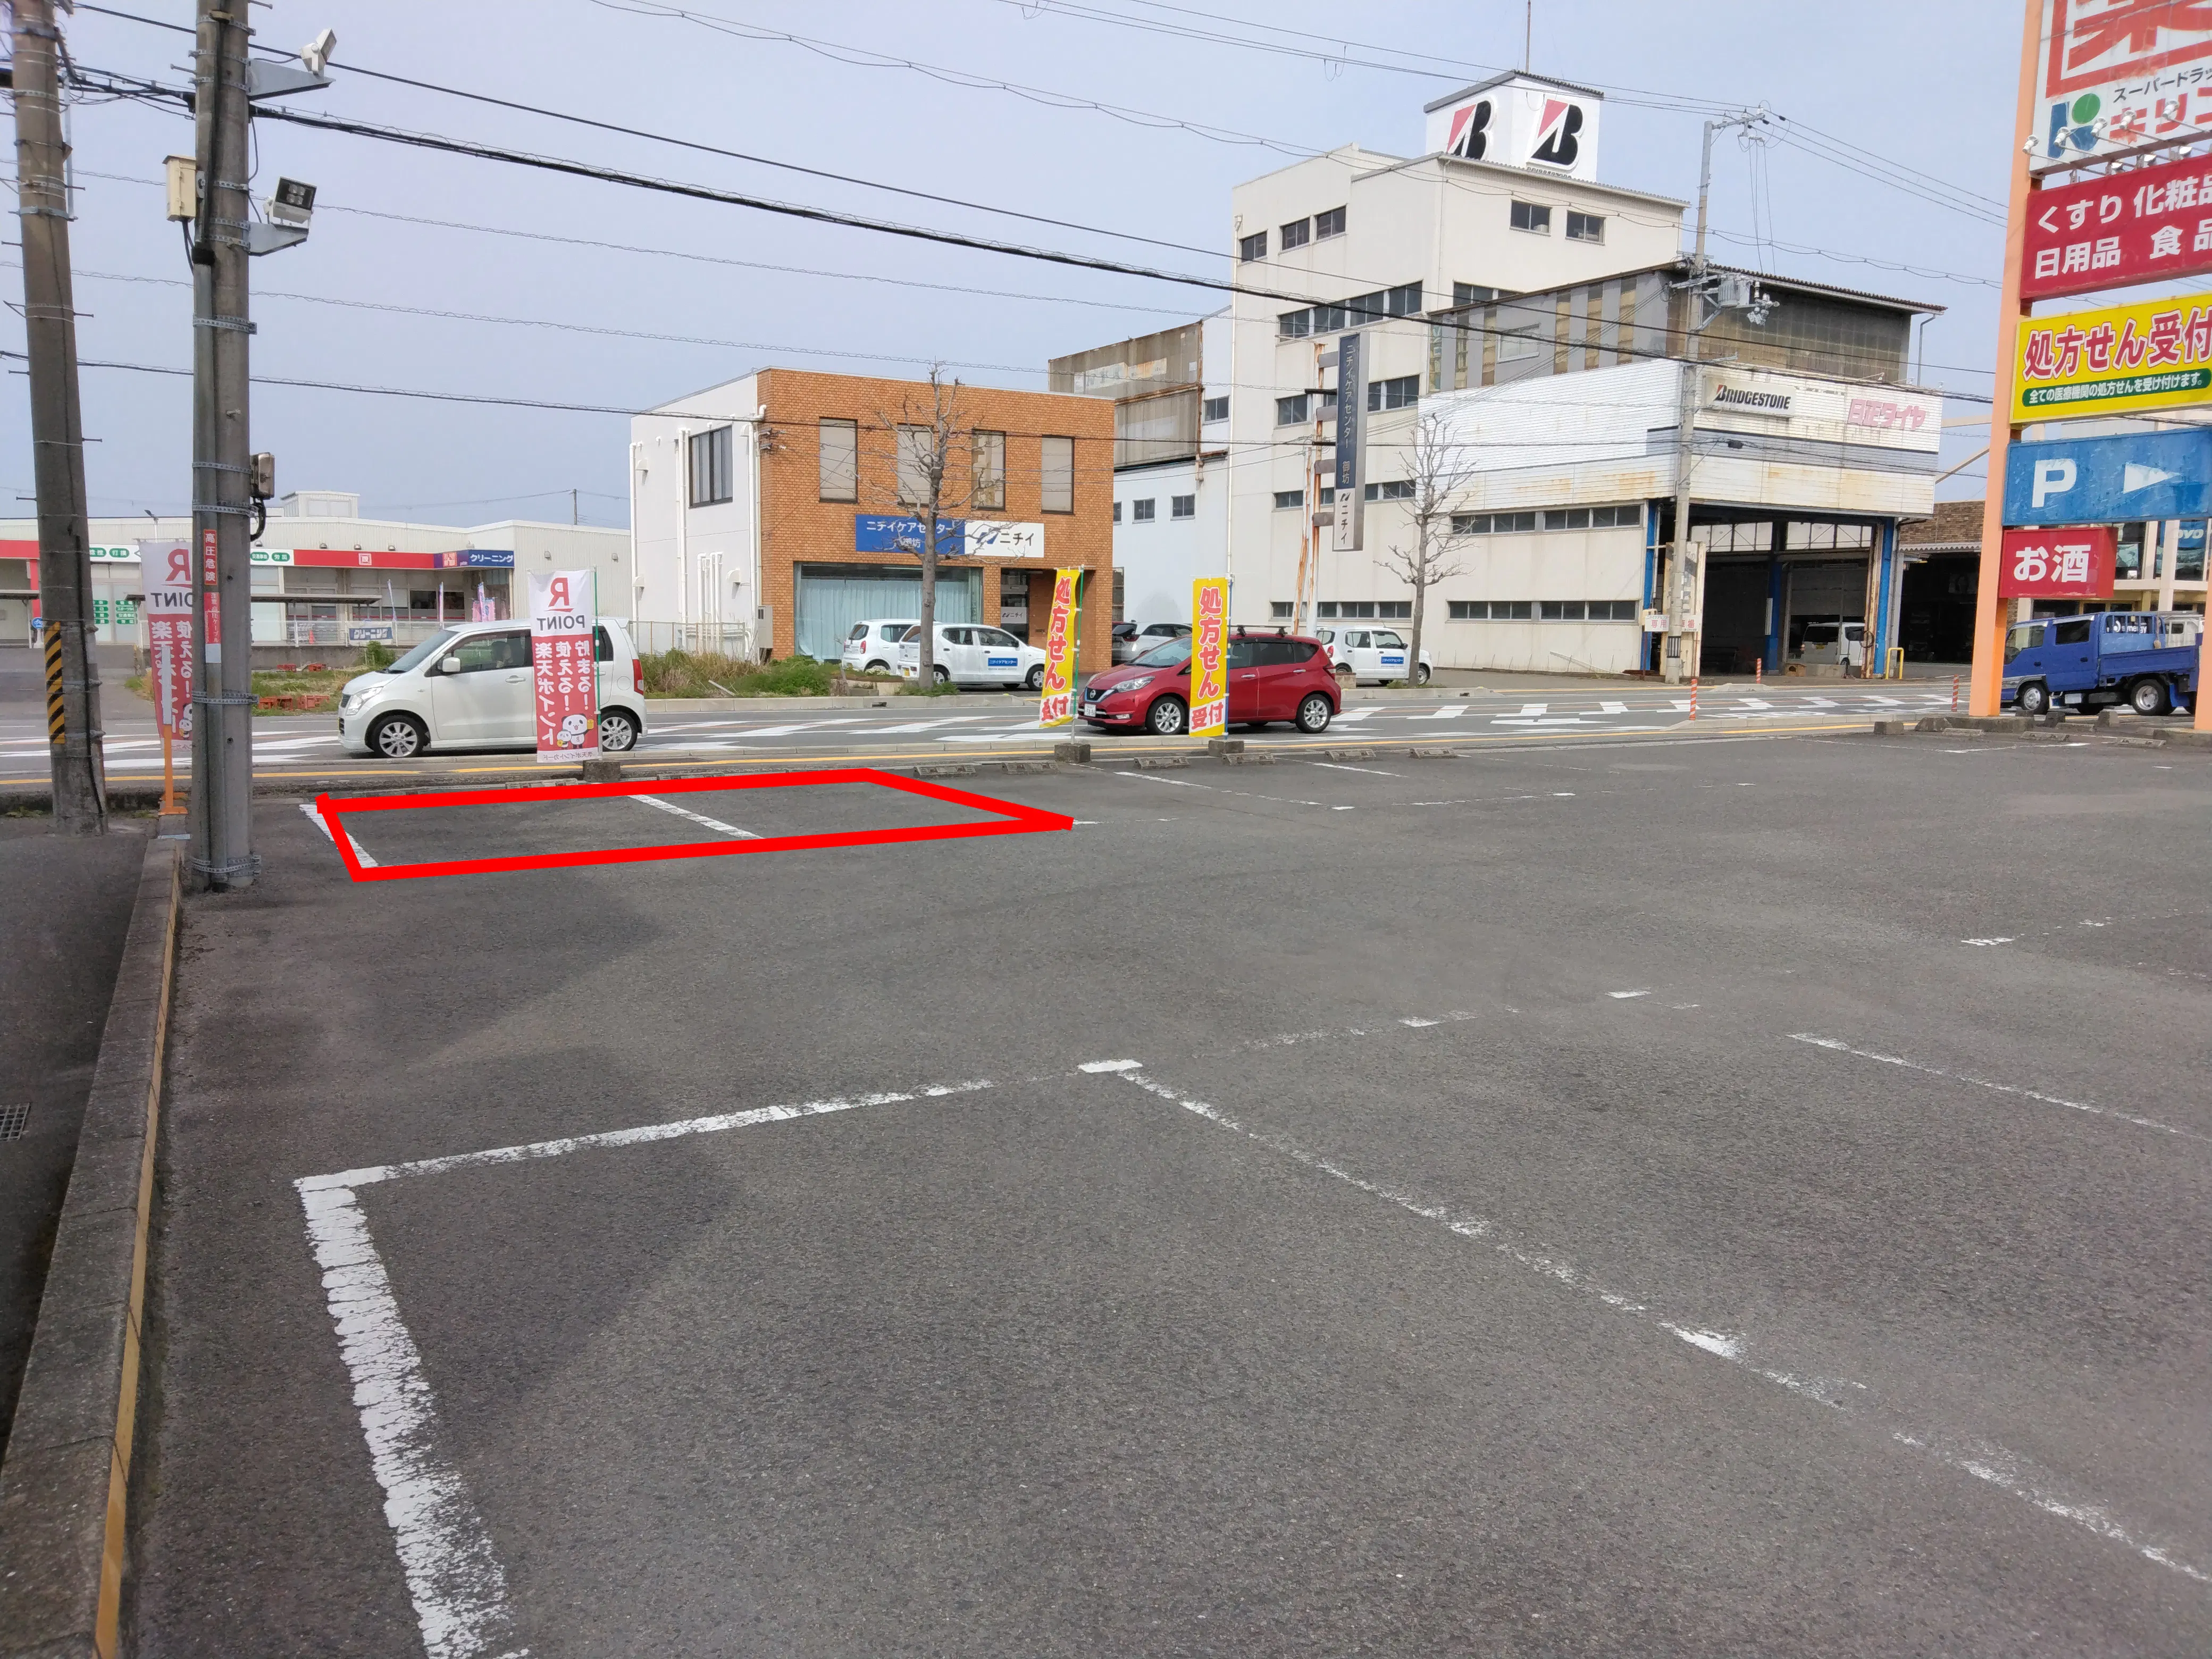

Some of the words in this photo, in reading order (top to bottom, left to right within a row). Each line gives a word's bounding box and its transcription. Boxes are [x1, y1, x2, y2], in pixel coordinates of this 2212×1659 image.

[2038, 195, 2122, 233] くすり
[2034, 236, 2121, 279] 日用品
[2023, 305, 2212, 381] 処方せん受付
[1343, 344, 1355, 449] ニチイケアセンター
[1713, 384, 1791, 409] BRIDGESTONE
[2029, 372, 2202, 404] 全ての医療機関の処方せんを受け付けます。
[1847, 399, 1926, 431] 日正タイヤ
[1342, 461, 1351, 484] 御坊
[2032, 458, 2077, 508] P
[866, 521, 953, 534] ニチイケアセター
[1000, 532, 1035, 547] ニチイ
[1340, 509, 1348, 545] ニチイ
[205, 533, 216, 582] 高圧危険
[470, 554, 514, 563] クリーニング
[2014, 544, 2091, 583] お酒
[354, 629, 388, 639] クリーニング
[1044, 576, 1073, 691] 処方せん
[1197, 586, 1223, 699] 処方せん
[2122, 625, 2147, 634] synegy
[1191, 702, 1224, 730] 受付
